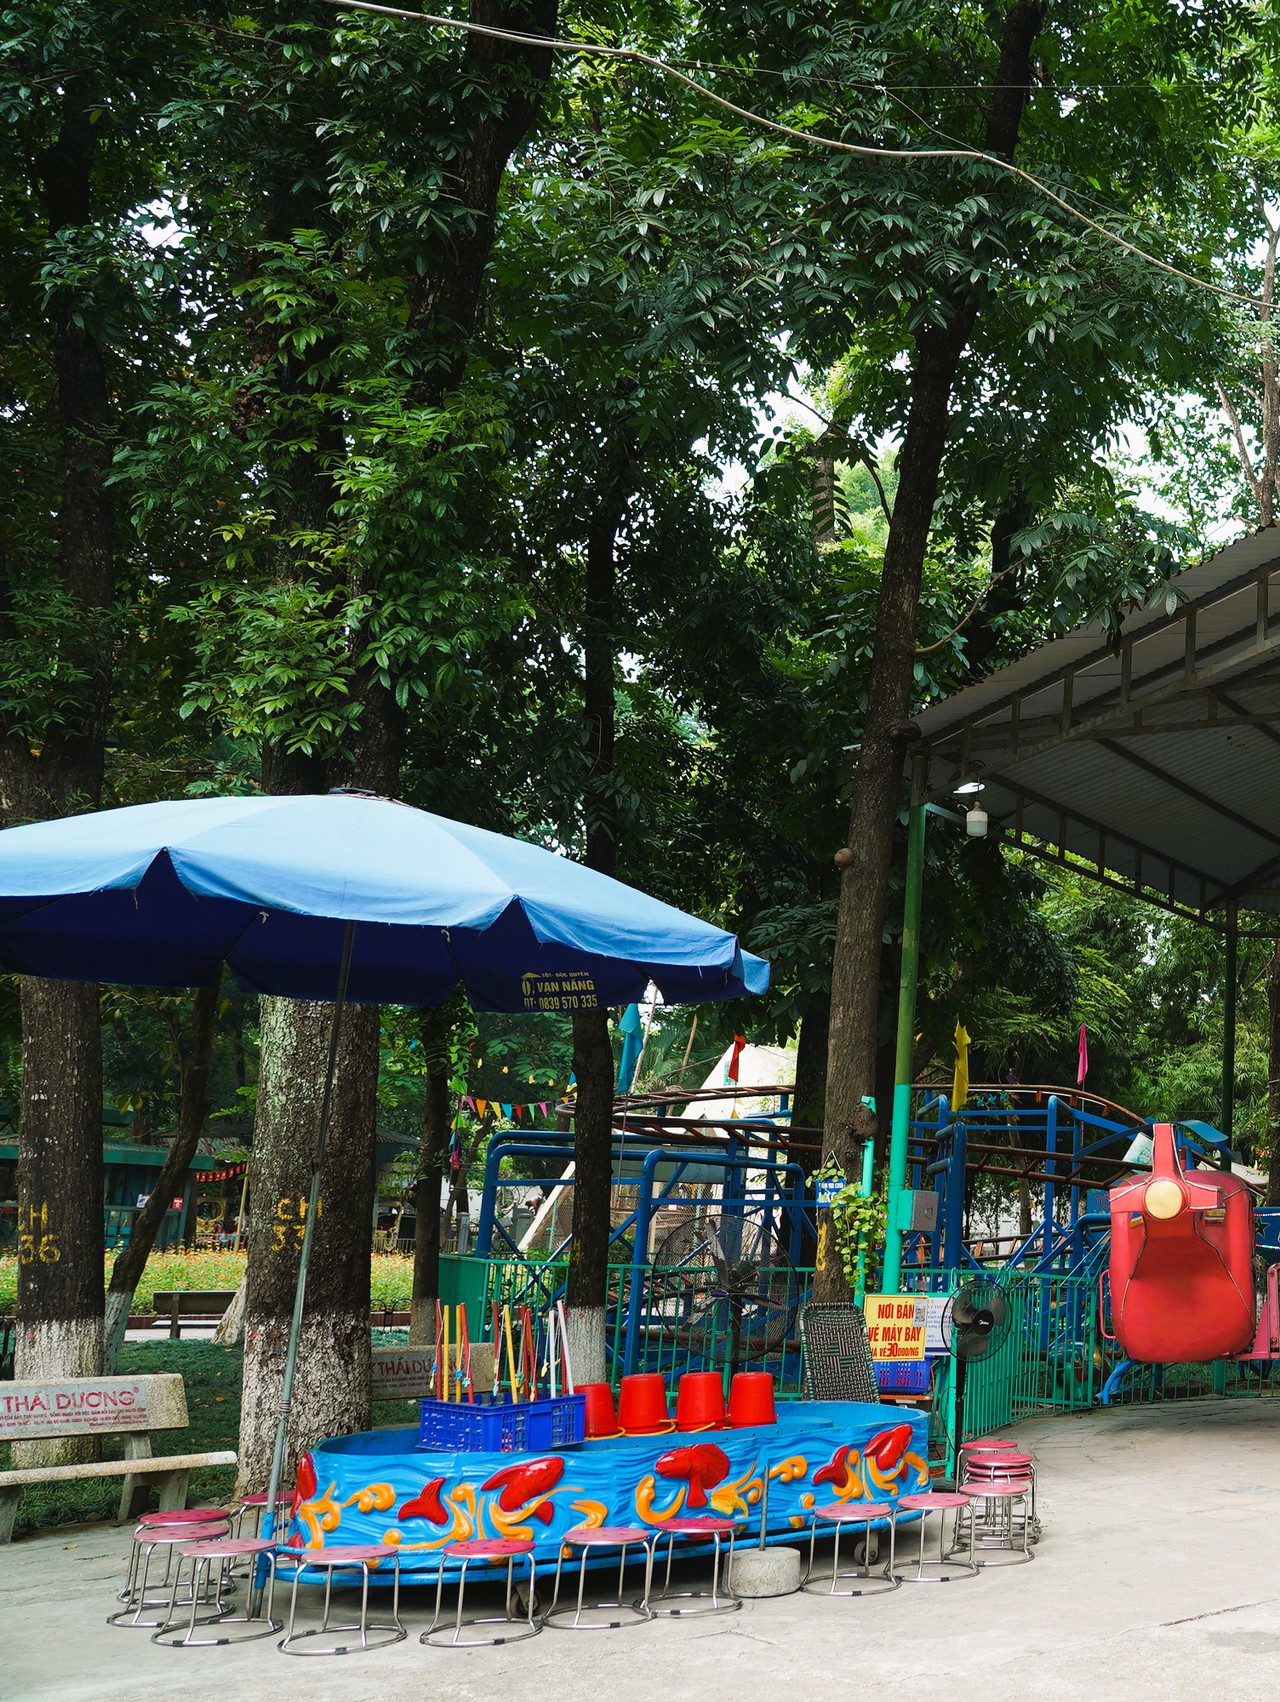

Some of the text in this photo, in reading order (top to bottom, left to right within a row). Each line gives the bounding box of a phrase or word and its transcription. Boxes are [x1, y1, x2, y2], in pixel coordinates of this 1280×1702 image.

[536, 981, 560, 995] VẠN
[562, 979, 595, 992] NĂNG
[538, 996, 560, 1010] 0839
[561, 995, 578, 1009] 570
[580, 994, 598, 1008] 335
[20, 1233, 61, 1264] 36
[877, 1303, 894, 1319] NƠI
[882, 1323, 903, 1342] MÁY
[904, 1326, 921, 1342] BAY
[4, 1389, 51, 1413] THÁI
